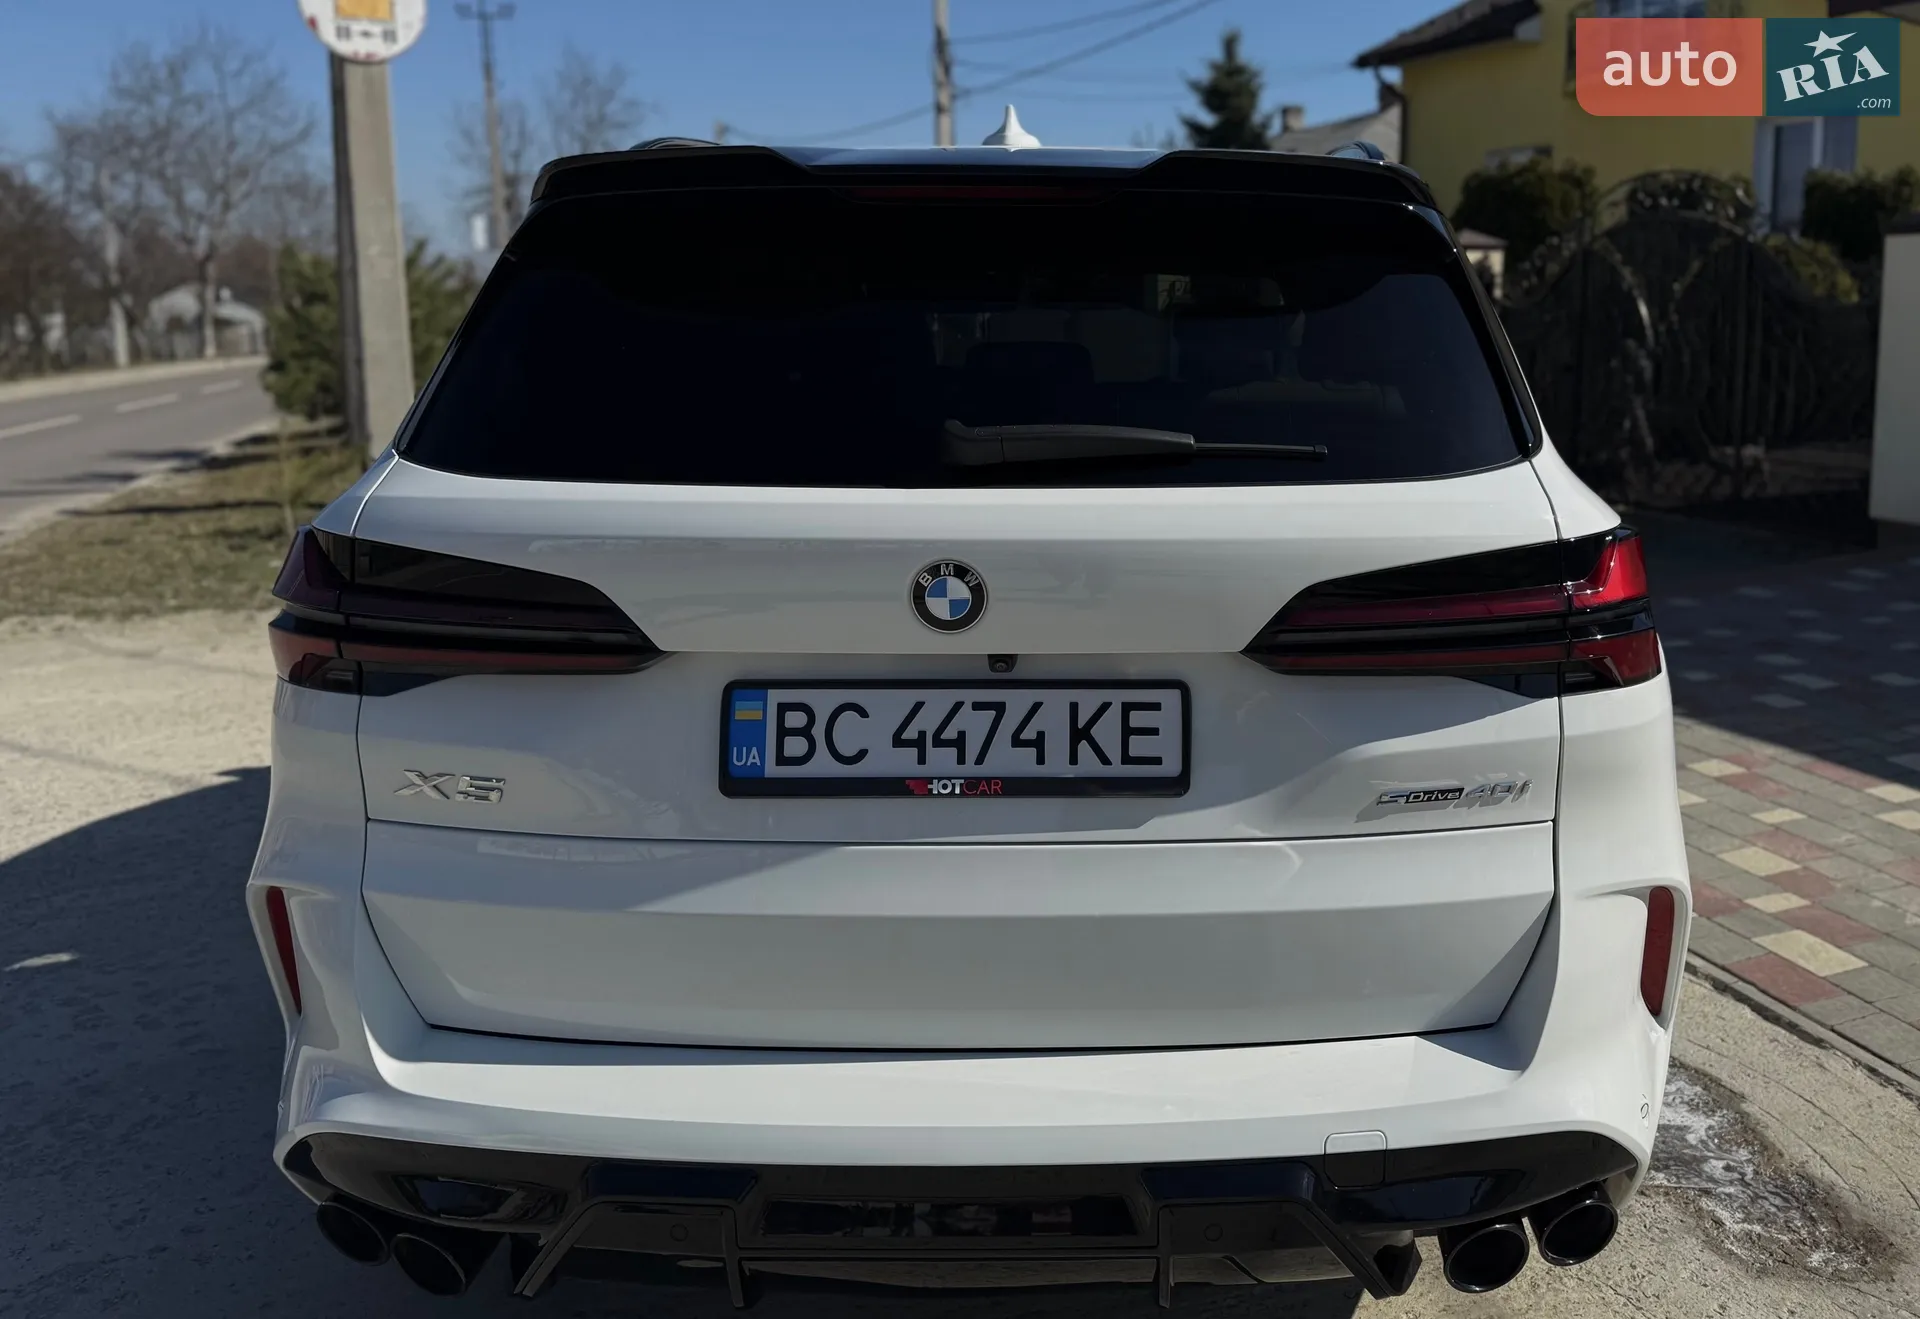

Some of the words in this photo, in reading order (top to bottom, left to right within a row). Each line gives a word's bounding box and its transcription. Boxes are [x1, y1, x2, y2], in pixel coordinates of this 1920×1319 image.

[918, 563, 980, 587] BMW
[775, 701, 870, 767] BC
[891, 701, 1047, 766] 4474
[1068, 701, 1164, 766] KE
[732, 746, 761, 767] UA
[393, 769, 506, 804] X5
